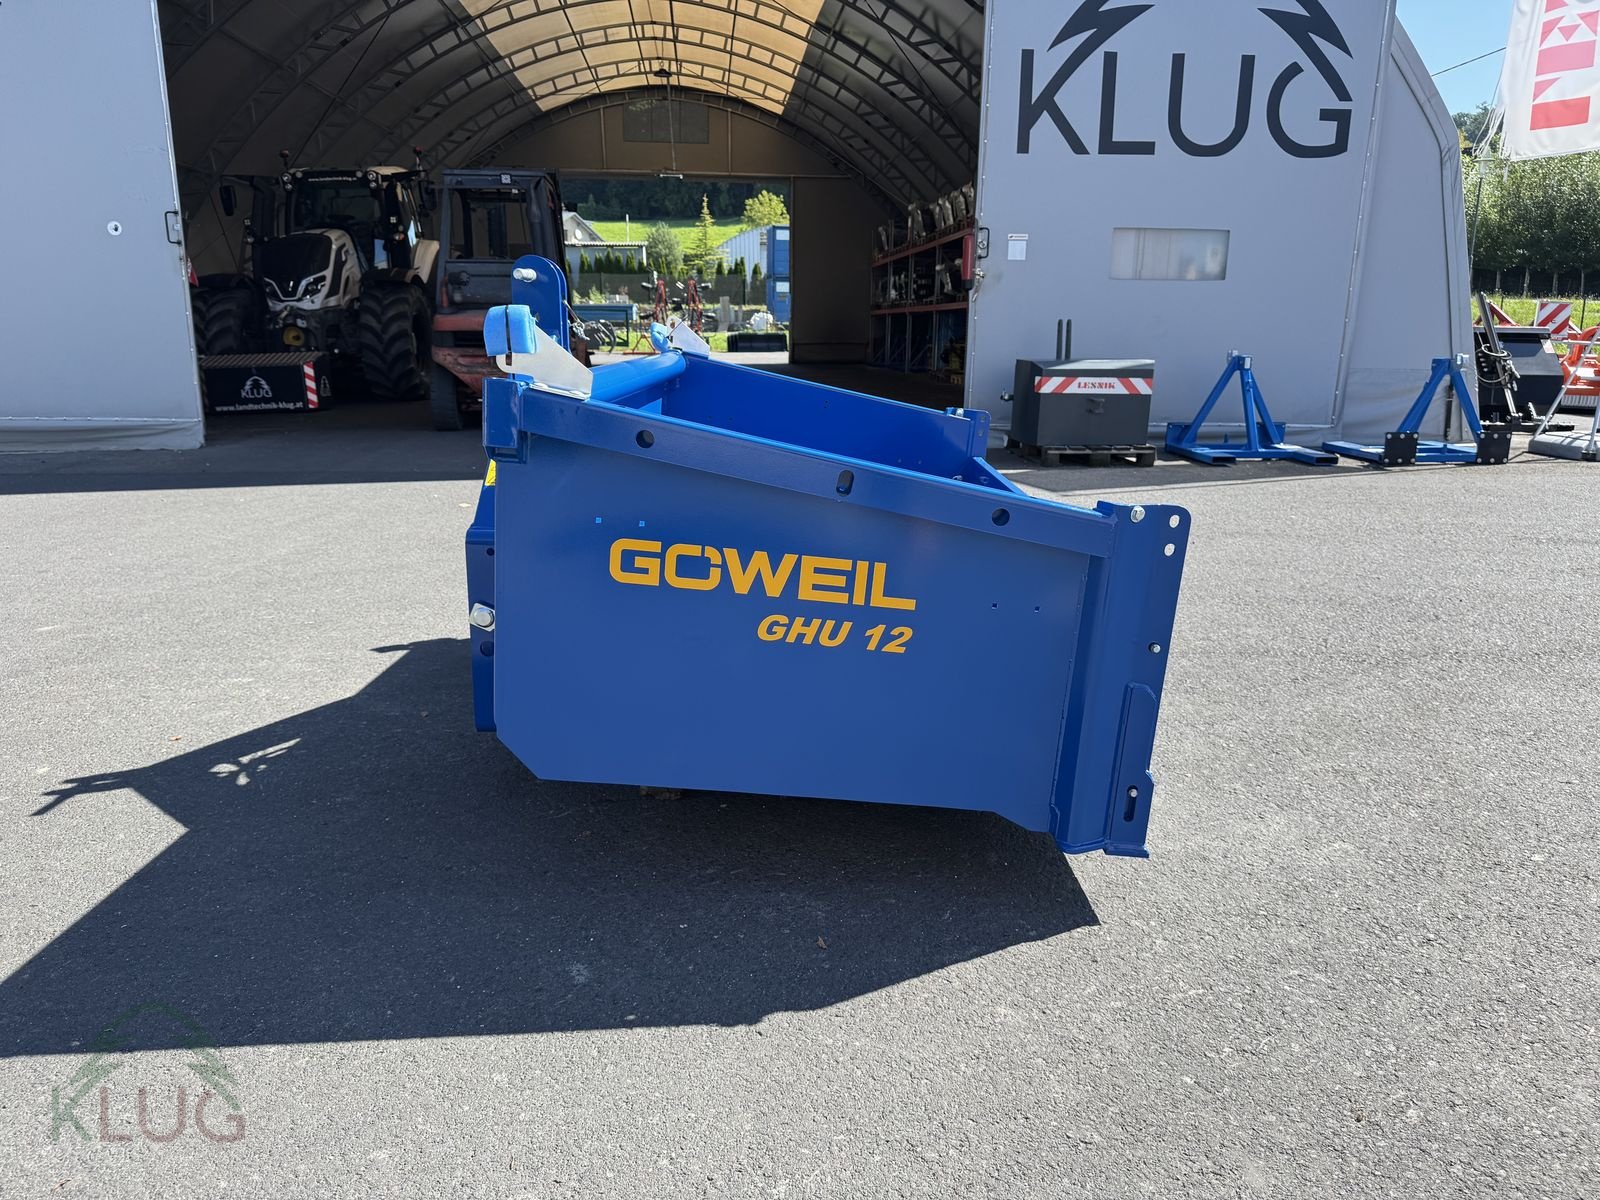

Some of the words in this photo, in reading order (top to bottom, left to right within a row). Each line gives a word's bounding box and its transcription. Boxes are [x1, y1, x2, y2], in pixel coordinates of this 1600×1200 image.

[1016, 49, 1352, 158] KLUG
[241, 388, 272, 398] KLUG
[215, 401, 304, 411] www.landtechnik-klug.at
[757, 614, 853, 648] GHU
[864, 624, 914, 654] 12
